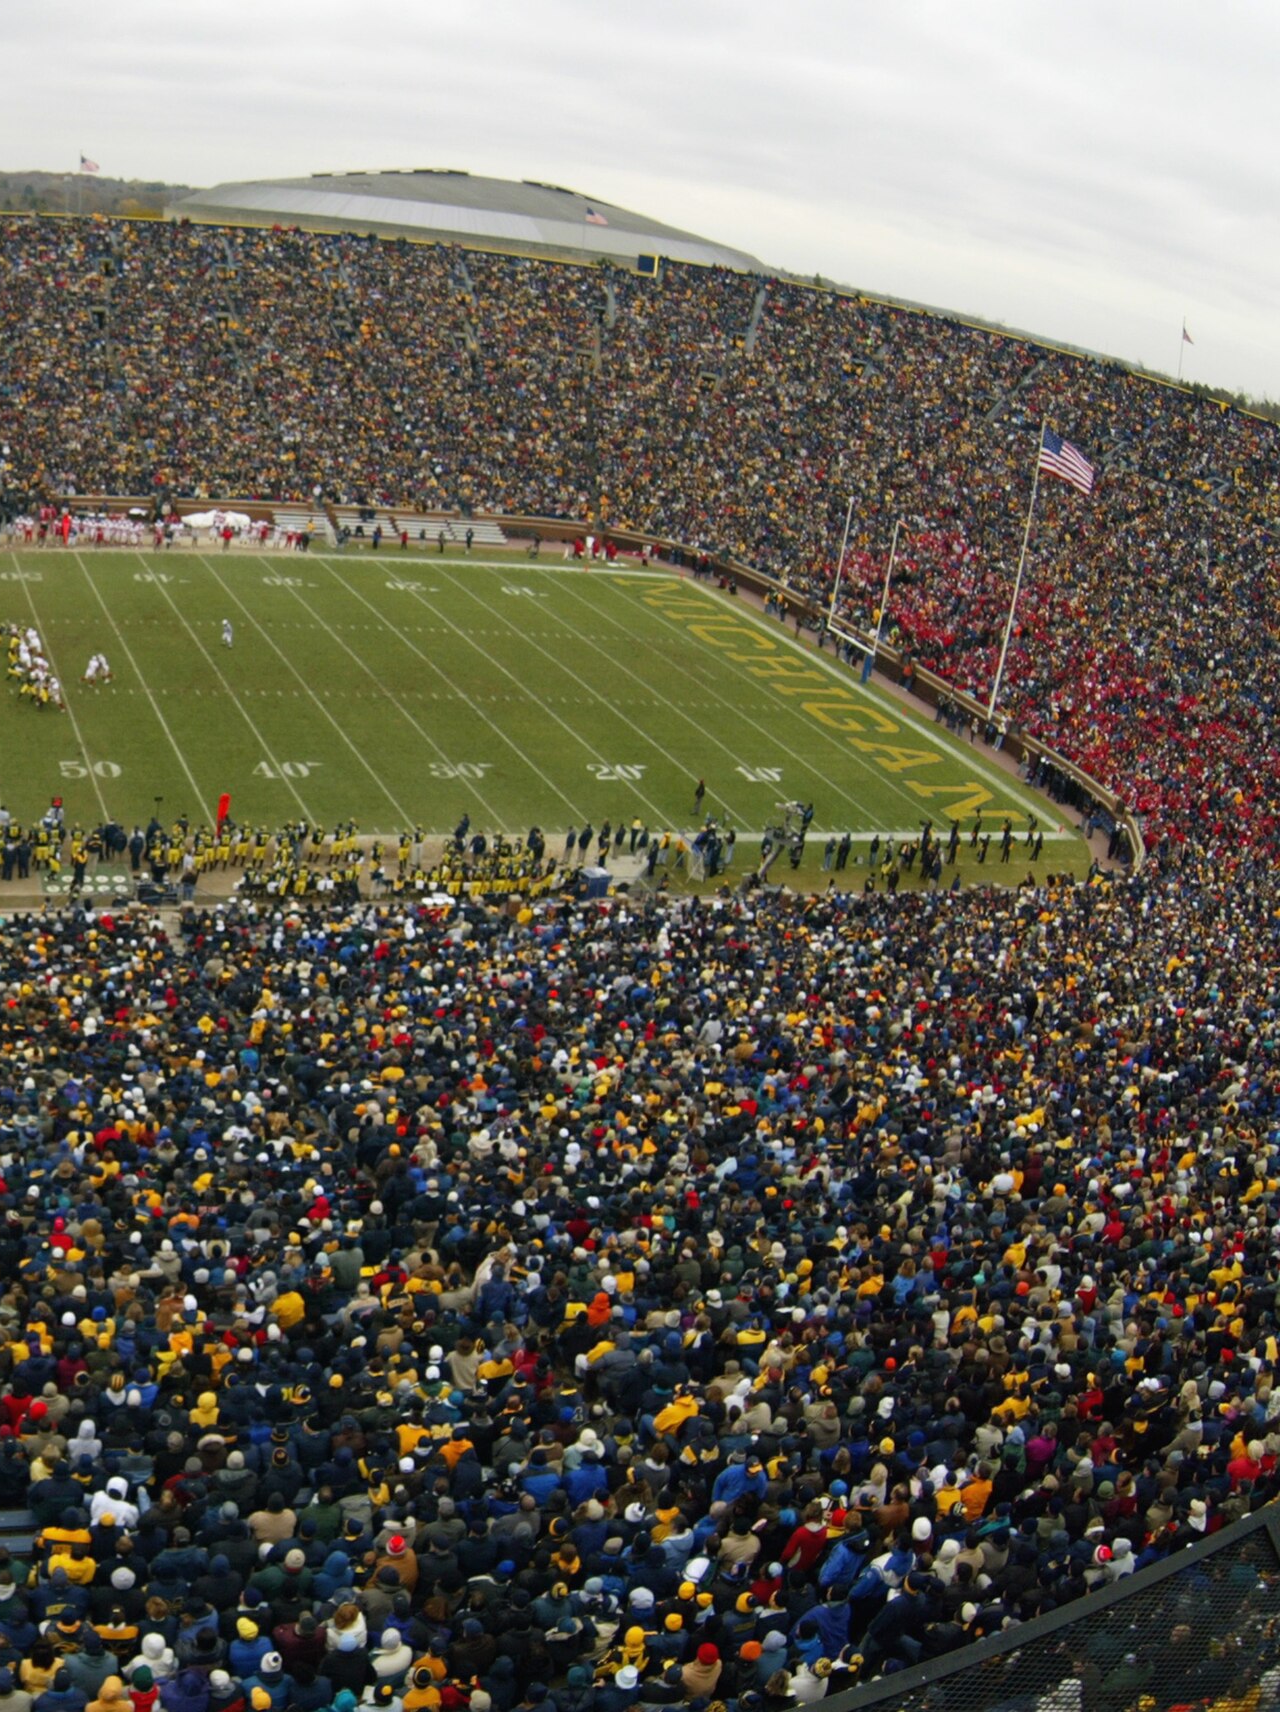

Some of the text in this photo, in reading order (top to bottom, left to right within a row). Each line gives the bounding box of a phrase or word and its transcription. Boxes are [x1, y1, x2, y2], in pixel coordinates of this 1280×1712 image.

[611, 577, 1026, 823] MICHIGAN
[58, 761, 122, 779] 50
[252, 761, 310, 779] 40
[428, 762, 484, 779] 30
[586, 764, 643, 780] 20
[734, 766, 782, 782] 10
